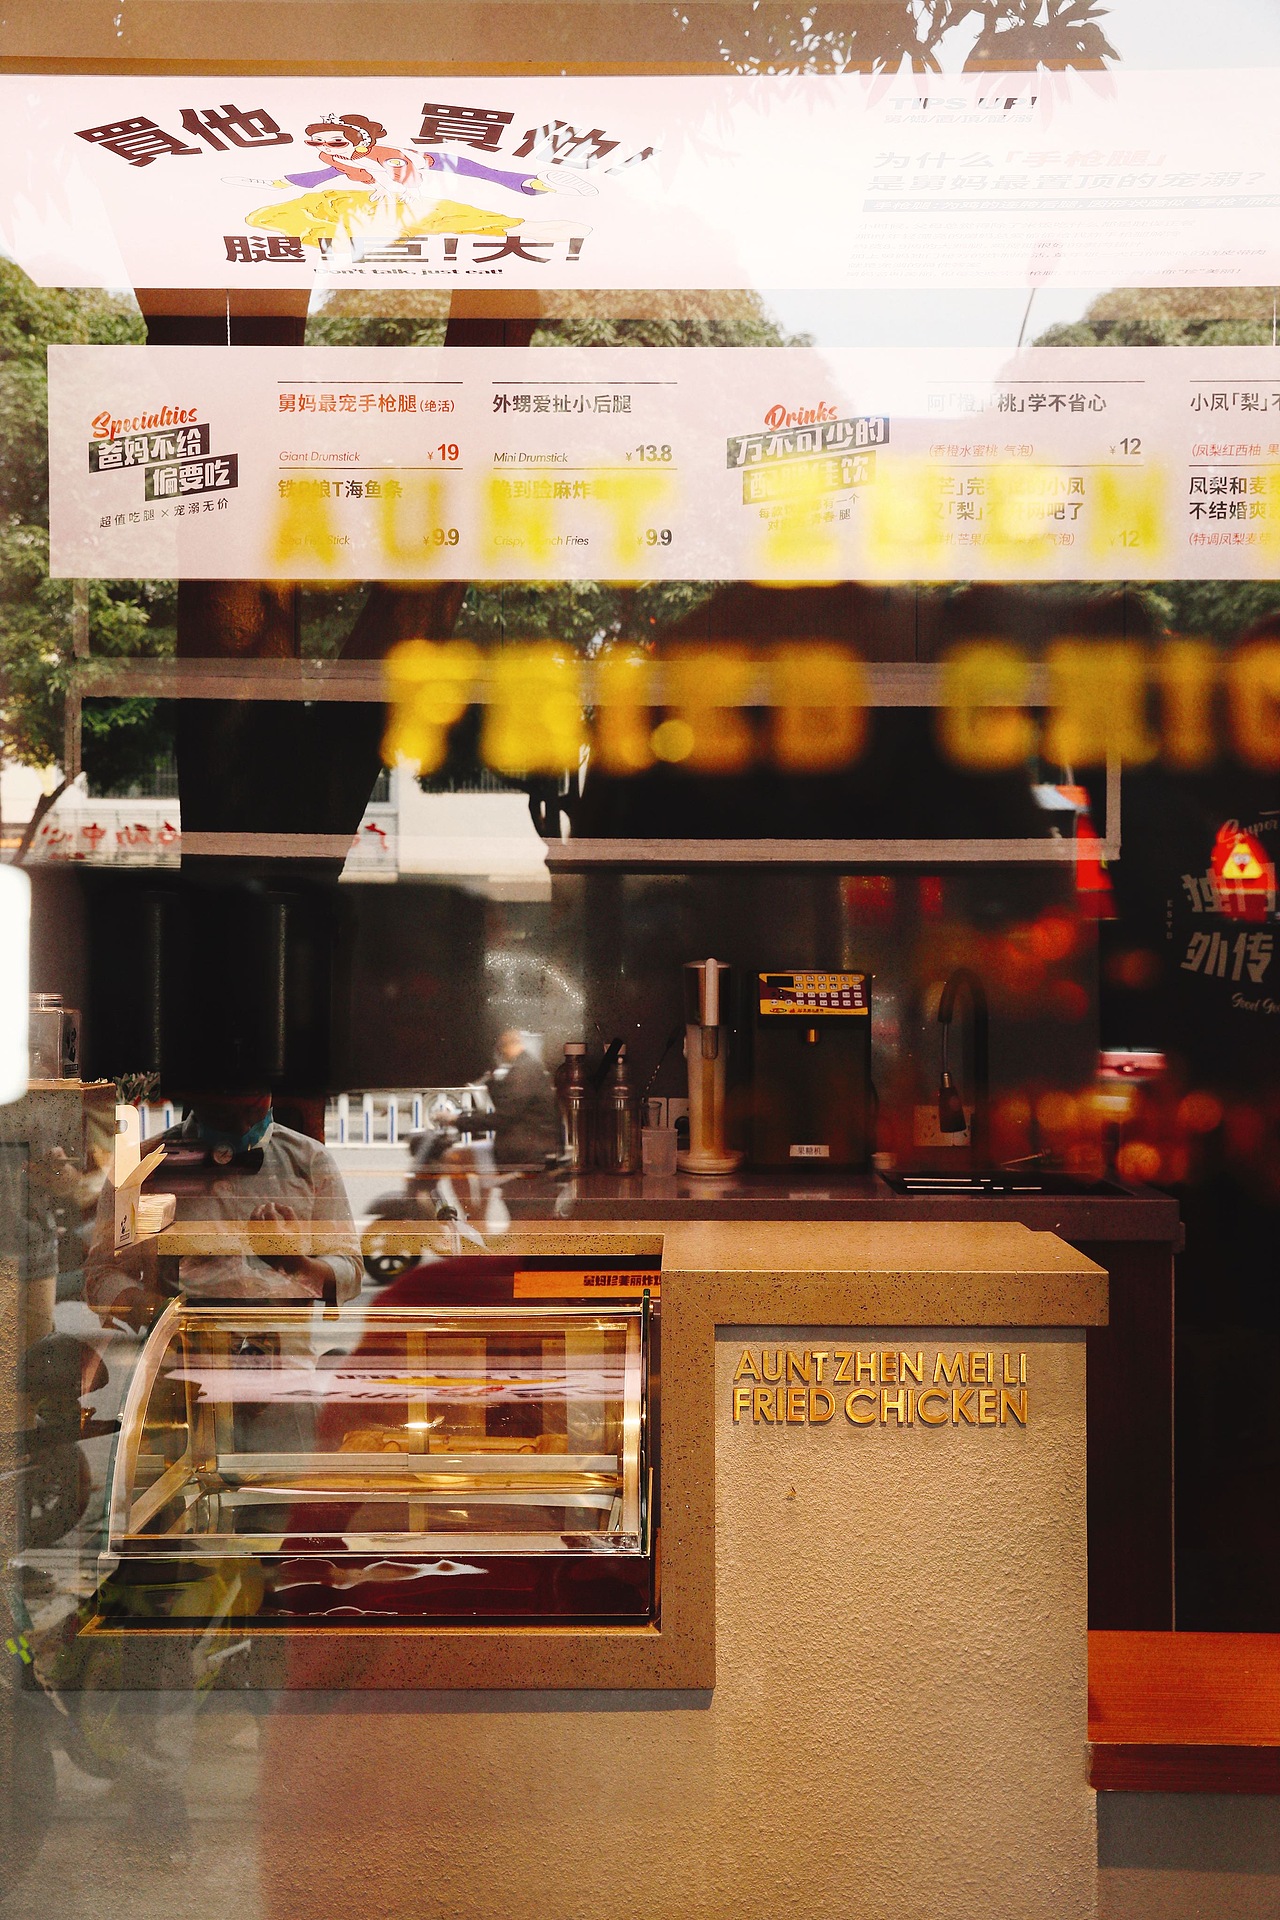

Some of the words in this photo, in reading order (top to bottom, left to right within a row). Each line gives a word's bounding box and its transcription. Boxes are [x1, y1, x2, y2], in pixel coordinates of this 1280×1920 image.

[492, 394, 632, 414] 外甥爱扯小后腿
[764, 401, 839, 432] Drinks
[91, 405, 198, 441] Specialties
[97, 427, 201, 470] 爸妈不给
[279, 451, 308, 462] Giant
[311, 451, 360, 462] Drumstick
[493, 452, 517, 463] Mini
[519, 452, 568, 463] Drumstick
[152, 459, 230, 497] 偏要吃
[565, 534, 589, 546] Fries
[1180, 931, 1274, 984] 外传
[932, 1351, 994, 1384] MEI
[1002, 1351, 1027, 1384] LI
[732, 1386, 837, 1424] FRIED
[843, 1386, 1028, 1425] CHICKEN
